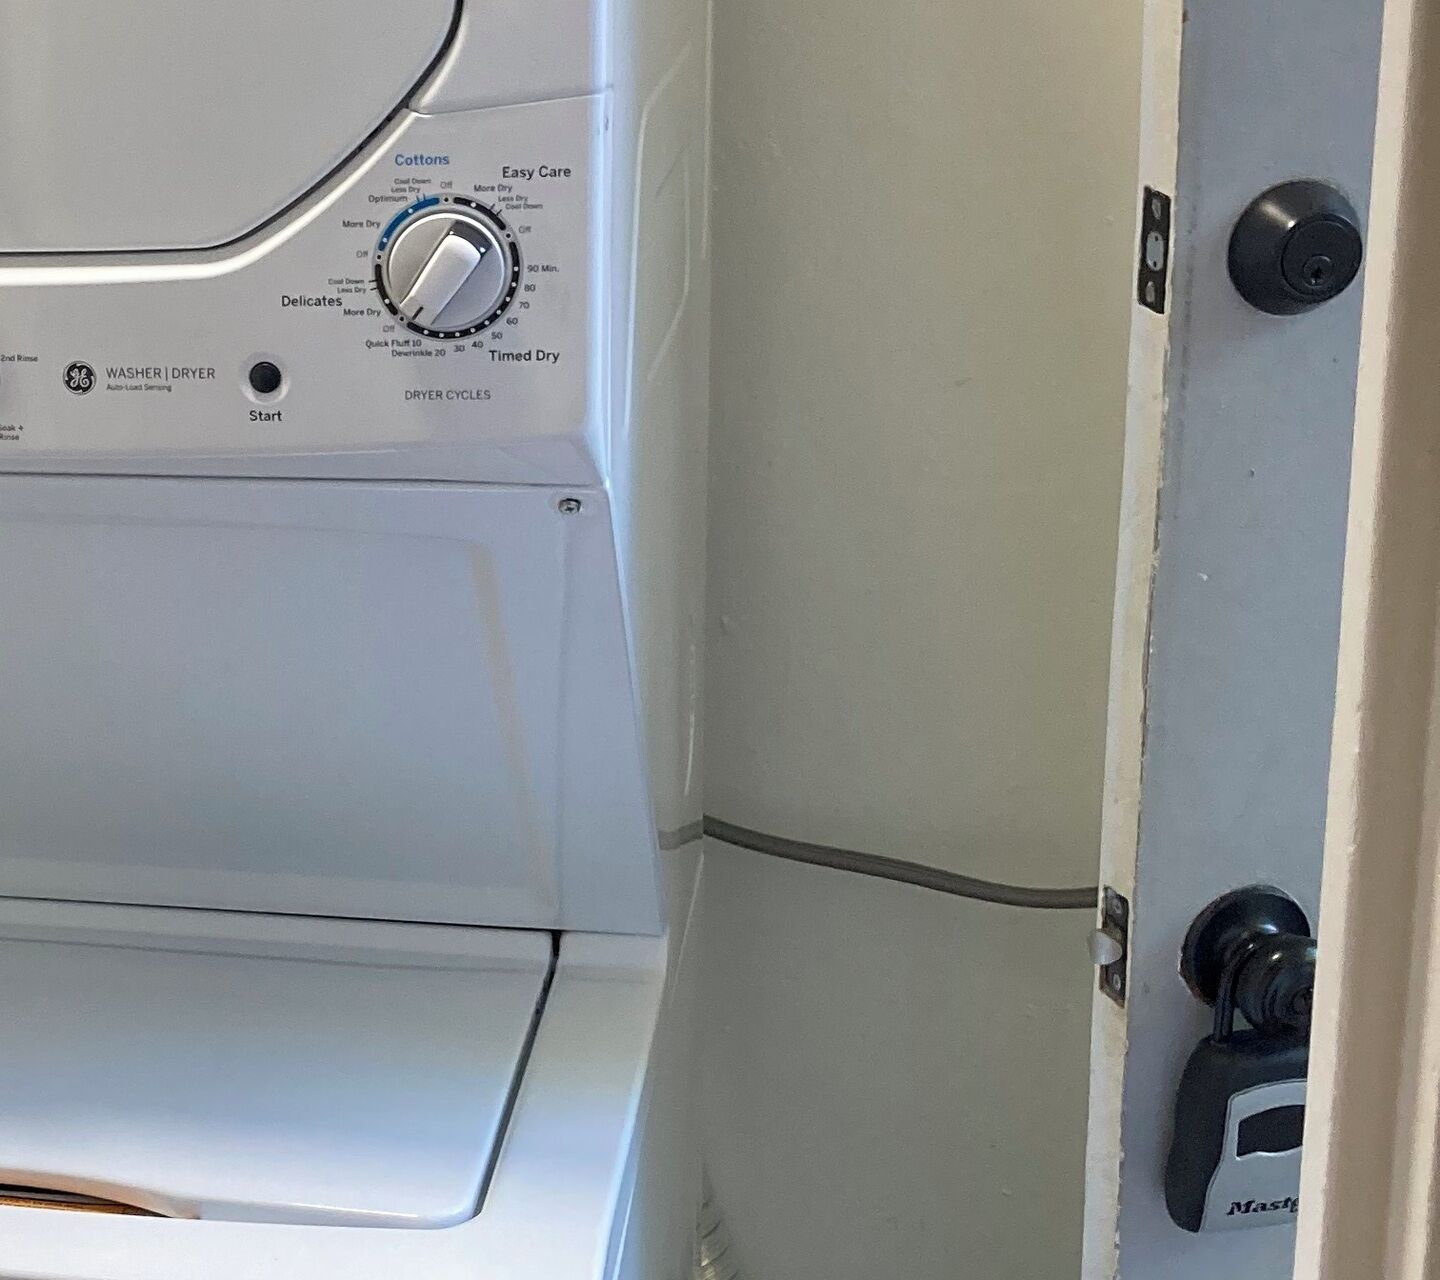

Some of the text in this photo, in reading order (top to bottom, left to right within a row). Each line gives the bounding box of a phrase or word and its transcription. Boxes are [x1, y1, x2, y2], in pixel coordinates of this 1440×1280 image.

[395, 153, 450, 166] Cottons
[502, 165, 572, 180] Easy Care
[440, 181, 453, 189] Off
[473, 184, 513, 193] More Dry
[368, 195, 408, 204] Optimum
[342, 220, 381, 229] More Dry
[356, 250, 368, 258] Off
[541, 264, 560, 273] Min.
[524, 284, 536, 292] 80
[281, 295, 343, 307] Delicates
[519, 301, 530, 309] 70
[343, 308, 381, 317] More Dry
[506, 317, 519, 326] 60
[382, 325, 395, 333] Off
[491, 332, 503, 340] 50
[365, 339, 422, 349] Quick Fluff 10
[471, 341, 484, 349] 40
[391, 349, 446, 357] Dewrinkle 20
[453, 345, 465, 353] 30
[0, 354, 38, 363] 2nd Rinse
[488, 350, 560, 364] Timed Dry
[105, 367, 216, 380] WASHER DRYER
[404, 390, 491, 400] DRYER CYCLES
[249, 410, 282, 422] Start
